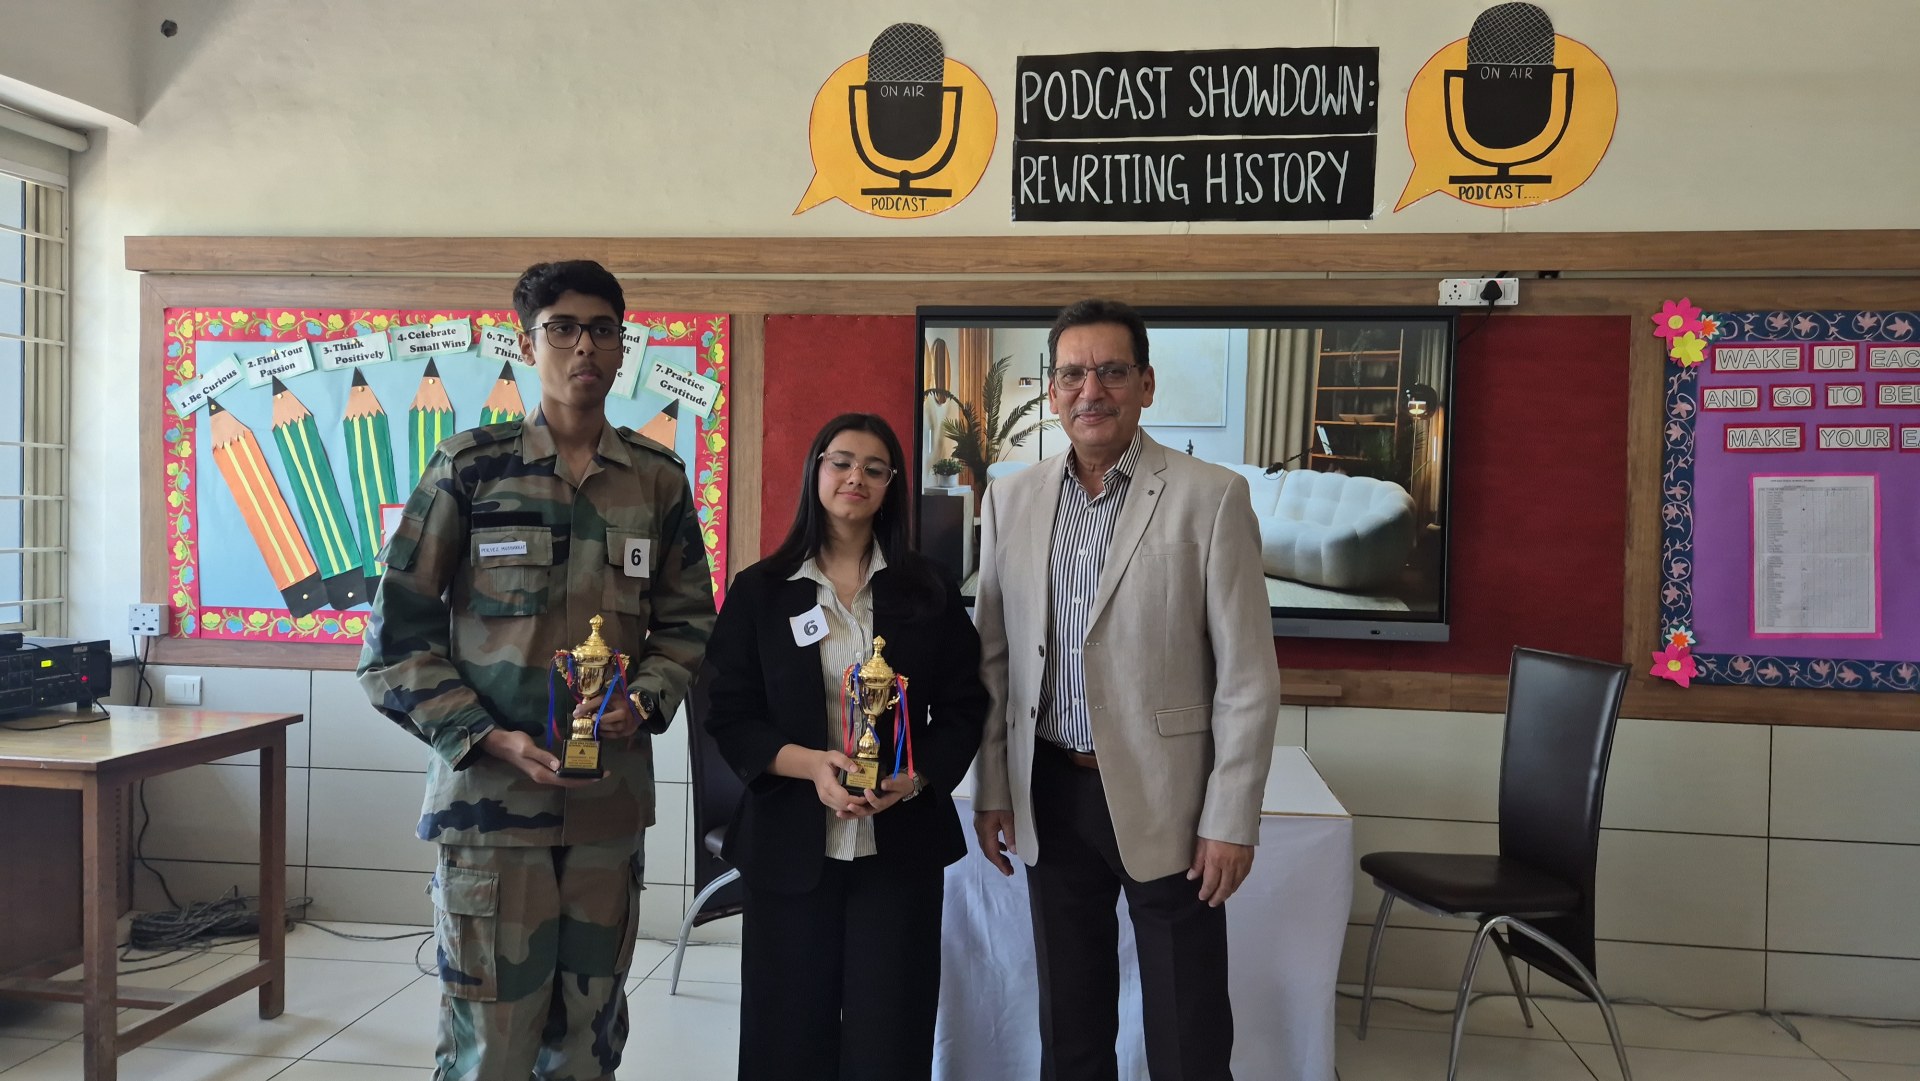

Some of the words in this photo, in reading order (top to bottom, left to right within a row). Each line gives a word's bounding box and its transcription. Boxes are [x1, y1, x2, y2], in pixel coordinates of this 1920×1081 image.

[1480, 66, 1500, 80] ON
[1509, 67, 1533, 80] AIR
[880, 85, 898, 97] ON
[903, 86, 925, 97] AIR
[1021, 66, 1173, 124] PODCAST
[1189, 63, 1376, 118] SHOWDOWN:
[1019, 154, 1190, 205] REWRITING
[1206, 150, 1350, 205] HISTORY
[282, 346, 304, 358] Your
[409, 343, 440, 353] Small
[441, 340, 466, 349] Wins
[335, 350, 385, 365] Positively
[1718, 349, 1798, 369] WAKE
[1817, 348, 1854, 368] UP
[260, 362, 297, 378] Passion
[202, 369, 238, 395] Curious
[659, 380, 708, 408] Gratitude
[1704, 389, 1756, 408] AND
[1773, 388, 1811, 406] GO
[1828, 386, 1861, 404] TO
[1728, 429, 1797, 447] MAKE
[1820, 429, 1889, 447] YOUR
[1902, 430, 1920, 447] E
[631, 548, 642, 566] 6
[803, 620, 819, 636] 6
